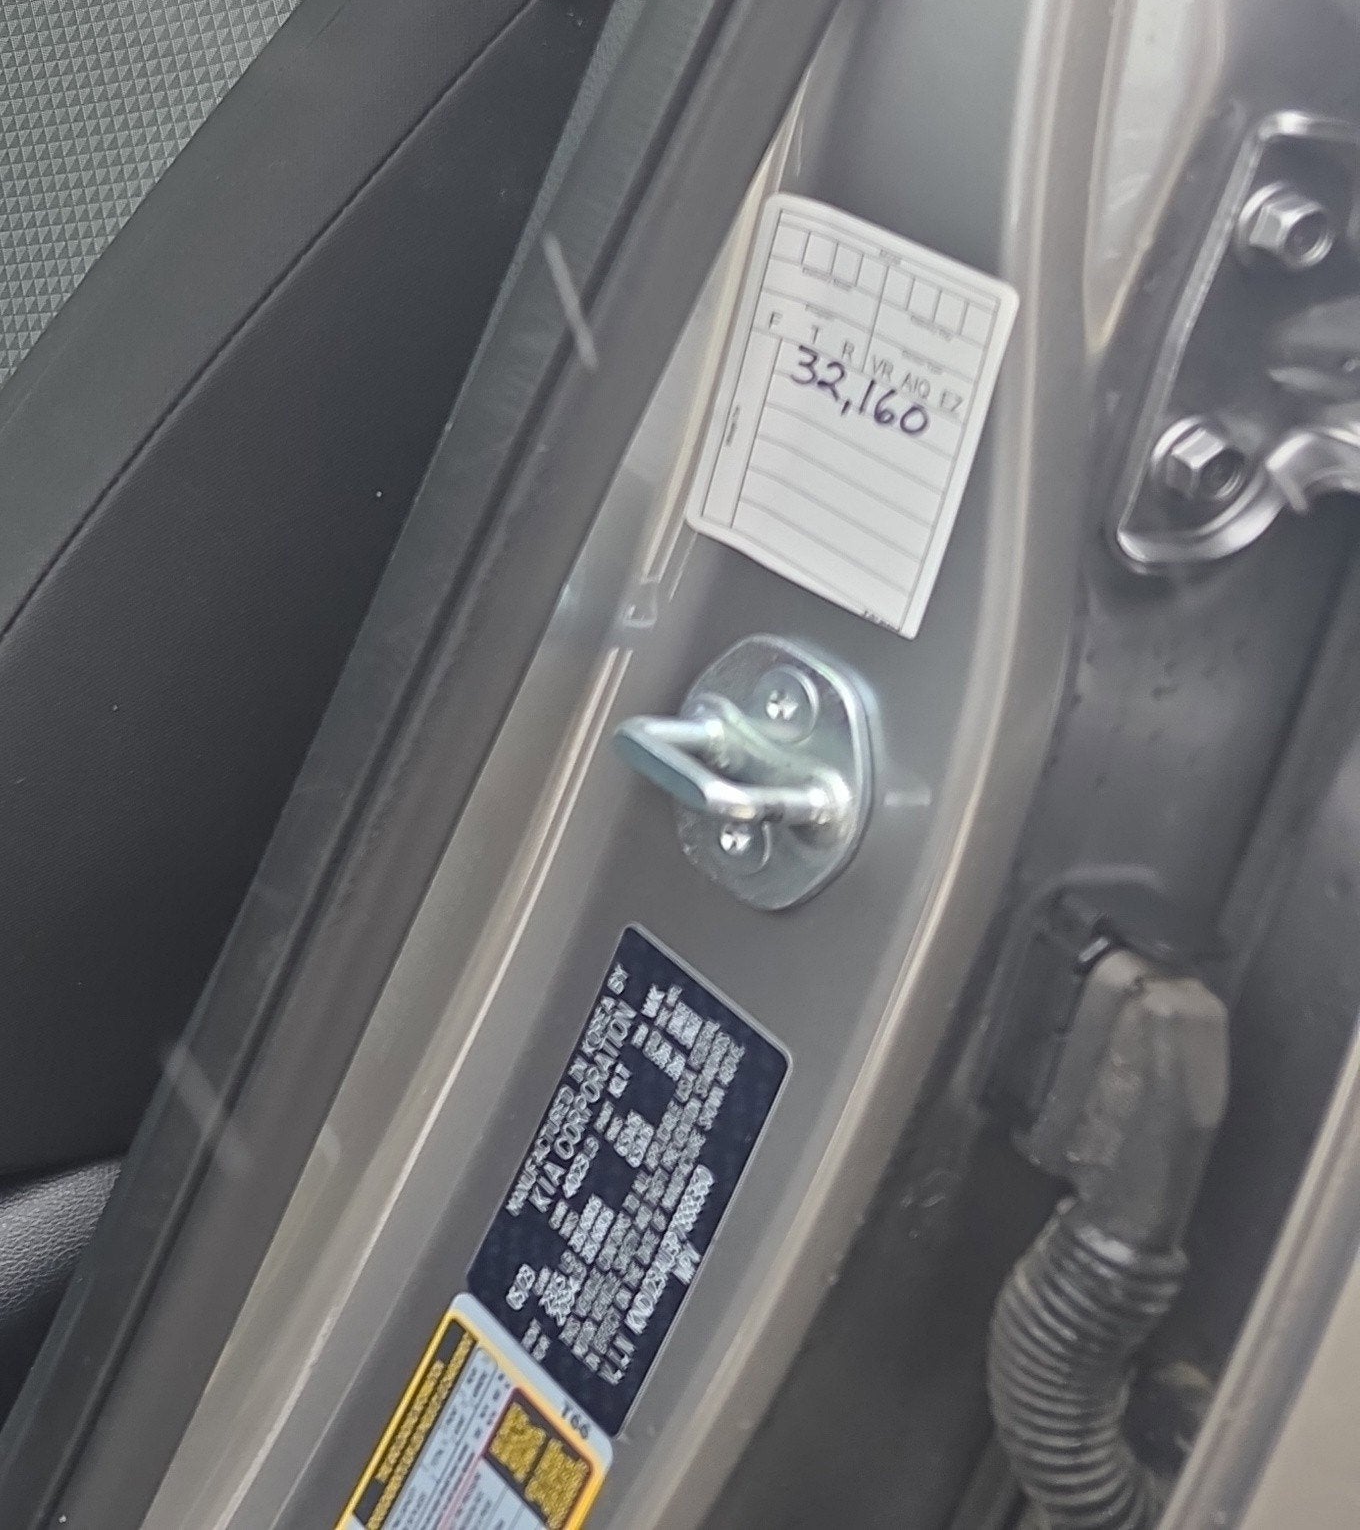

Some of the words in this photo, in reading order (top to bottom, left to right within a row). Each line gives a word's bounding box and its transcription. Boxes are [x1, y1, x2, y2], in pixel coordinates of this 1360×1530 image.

[790, 345, 930, 435] 32,160
[531, 1159, 563, 1213] KIA
[552, 1000, 636, 1162] CORPORATION
